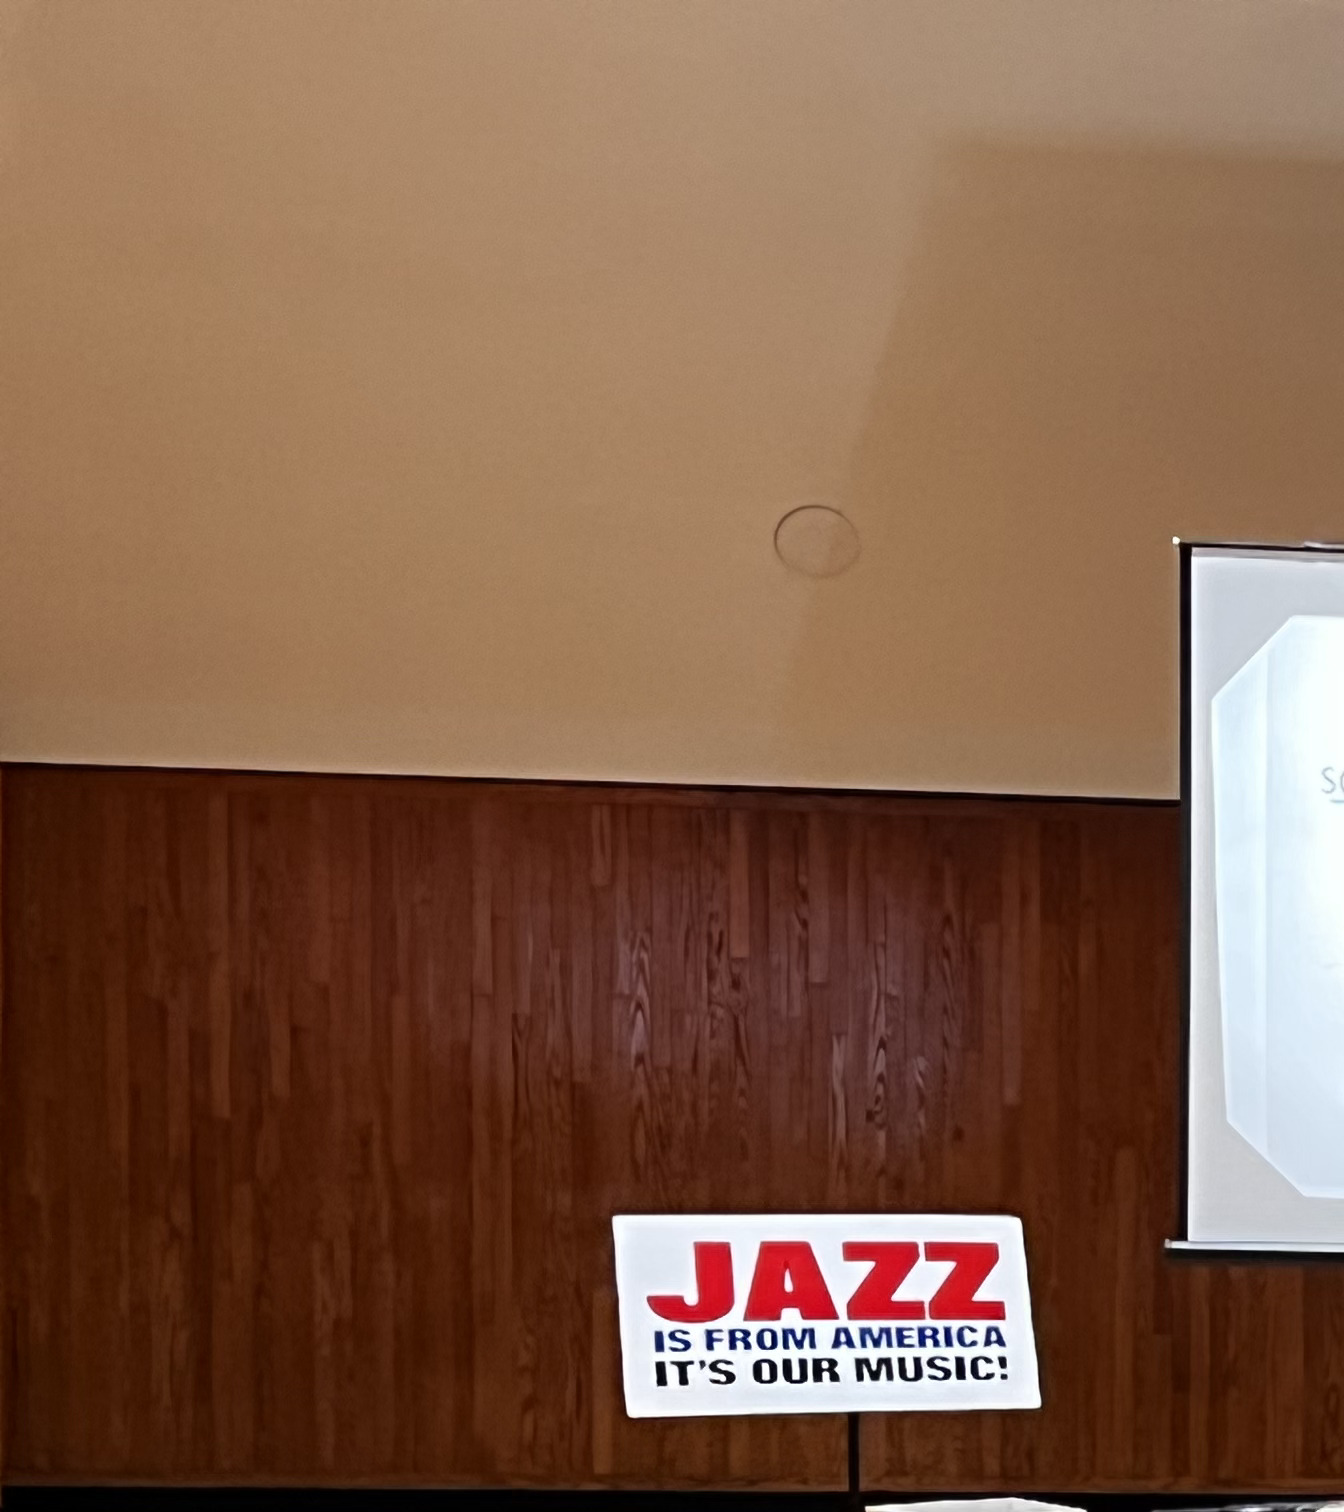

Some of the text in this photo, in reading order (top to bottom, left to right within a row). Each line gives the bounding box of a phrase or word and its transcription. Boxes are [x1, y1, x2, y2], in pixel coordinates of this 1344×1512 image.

[646, 1241, 1007, 1324] JAZZ
[653, 1323, 1008, 1354] IS FROM AMERICA
[654, 1354, 1010, 1388] IT'S OUR MUSIC!
